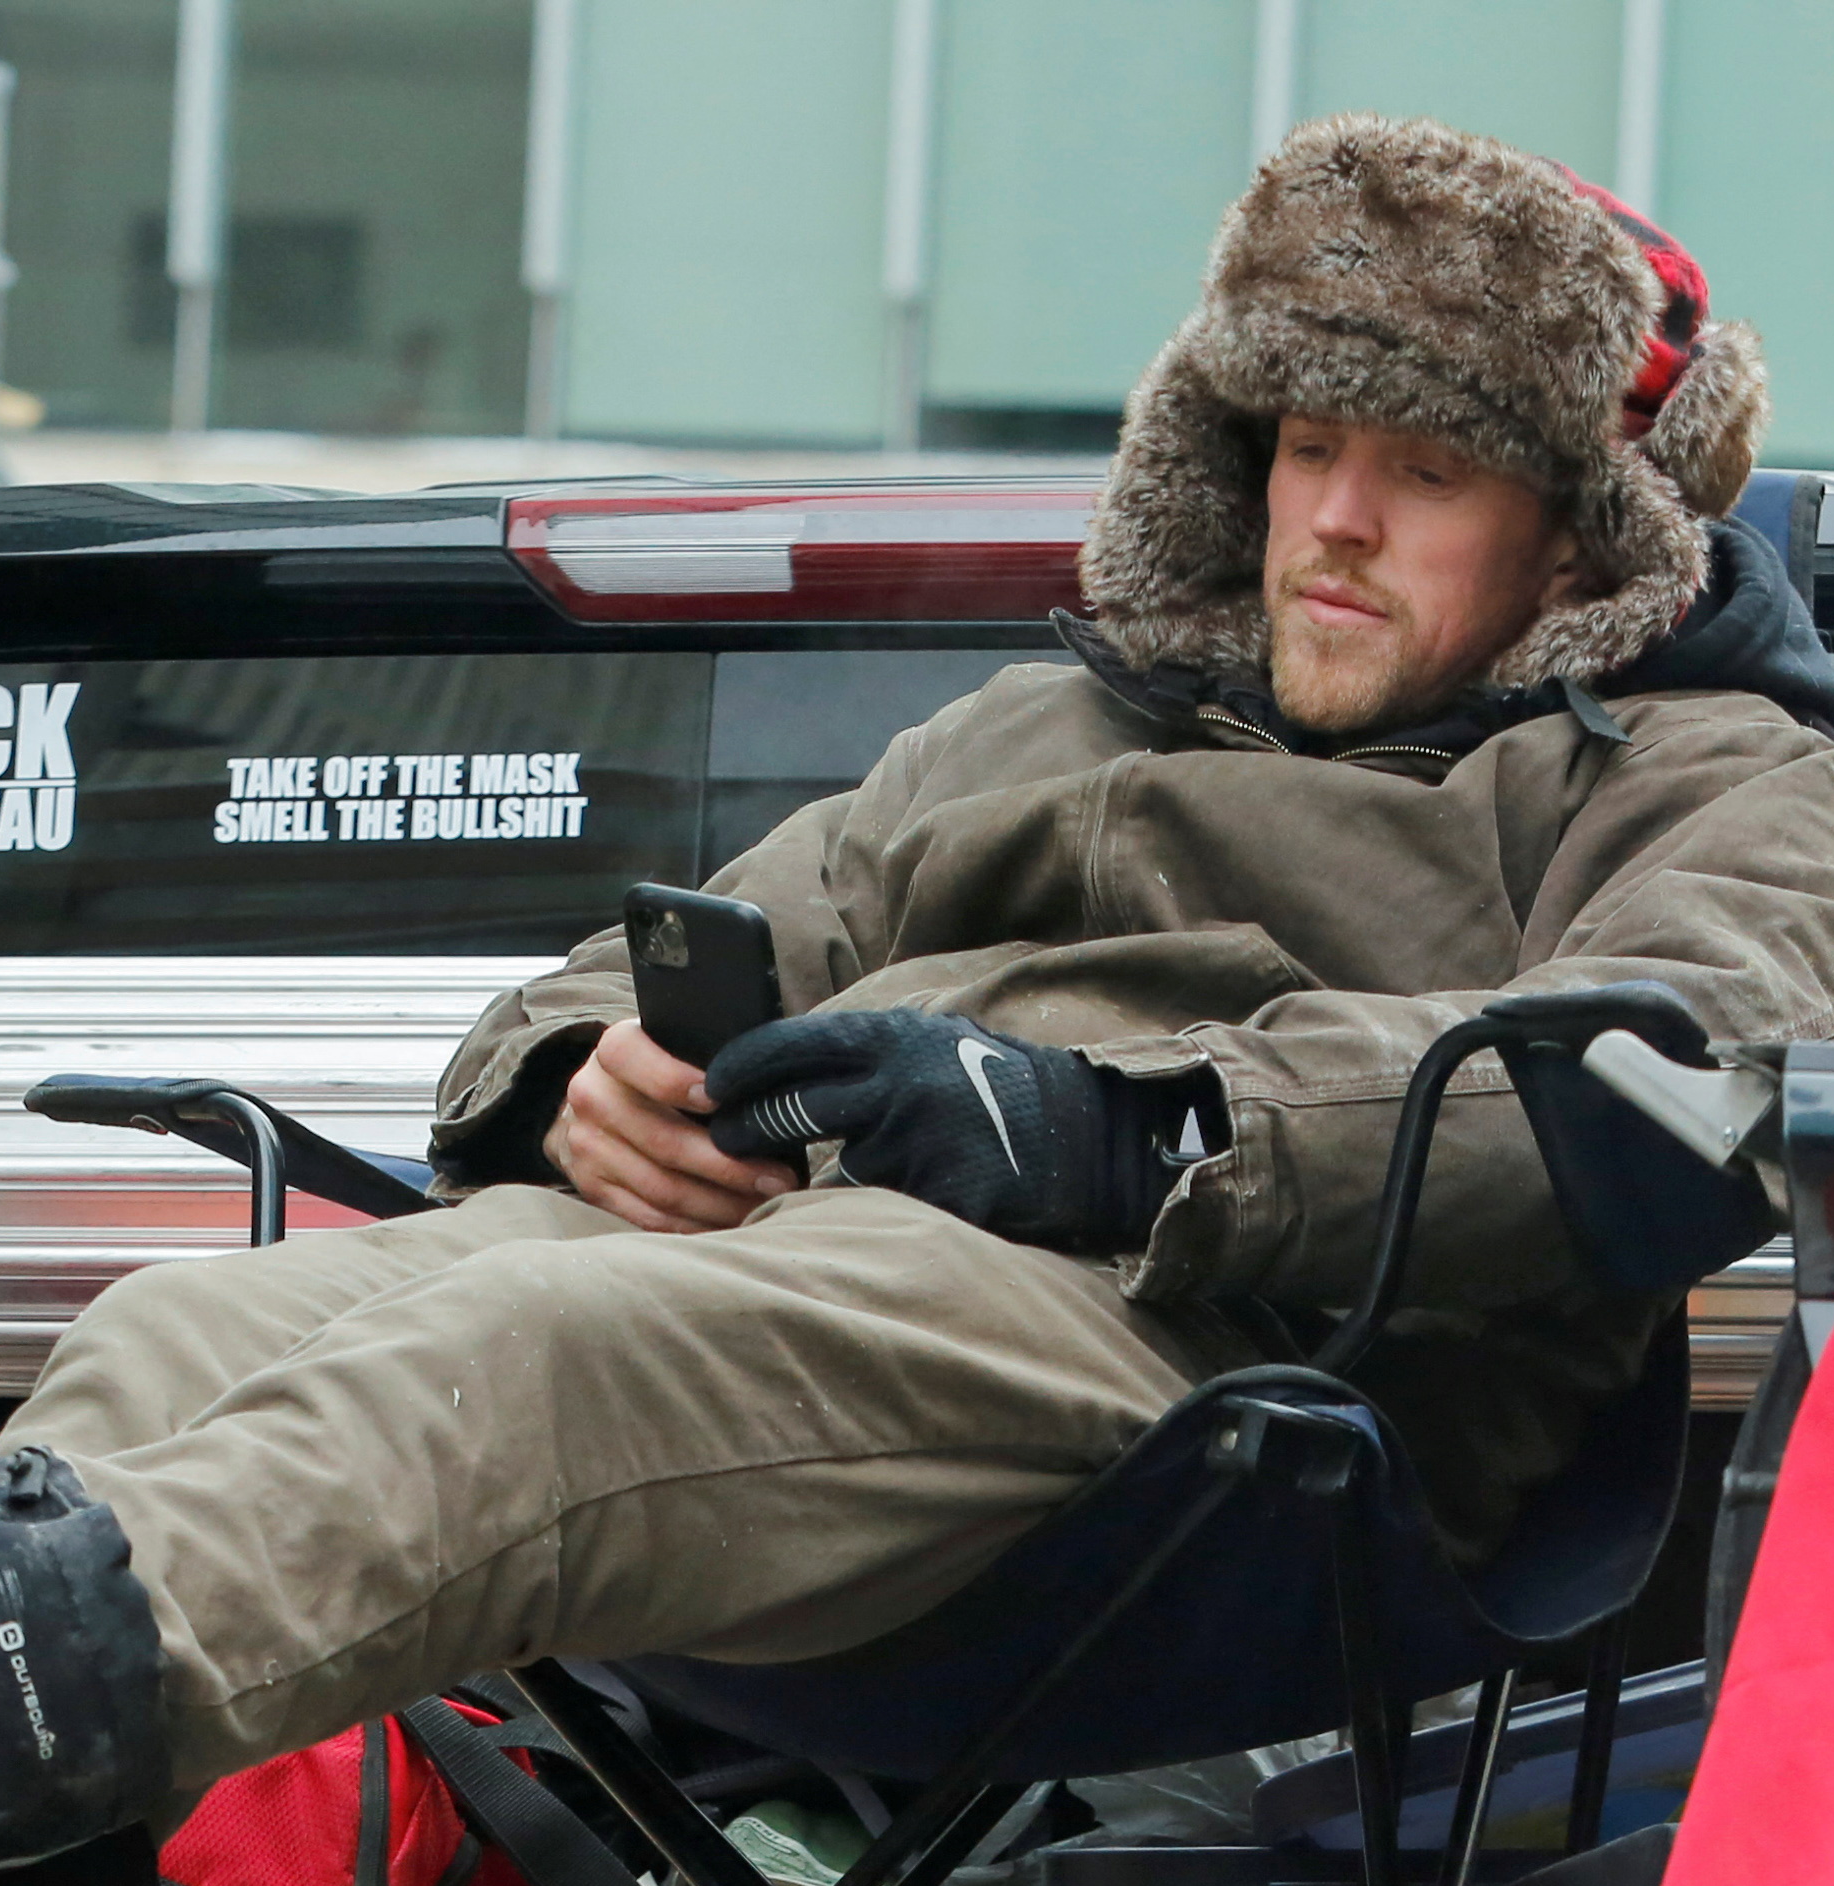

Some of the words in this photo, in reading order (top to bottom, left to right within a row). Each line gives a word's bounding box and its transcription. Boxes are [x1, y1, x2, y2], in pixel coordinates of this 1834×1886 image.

[226, 757, 318, 799] TAKE
[322, 755, 390, 798] OFF
[393, 754, 465, 796] THE
[469, 752, 581, 795] MASK
[213, 800, 329, 843] SMELL
[335, 799, 406, 841] THE
[410, 796, 588, 840] BULLSHIT
[10, 1654, 54, 1760] OUTBOUND
